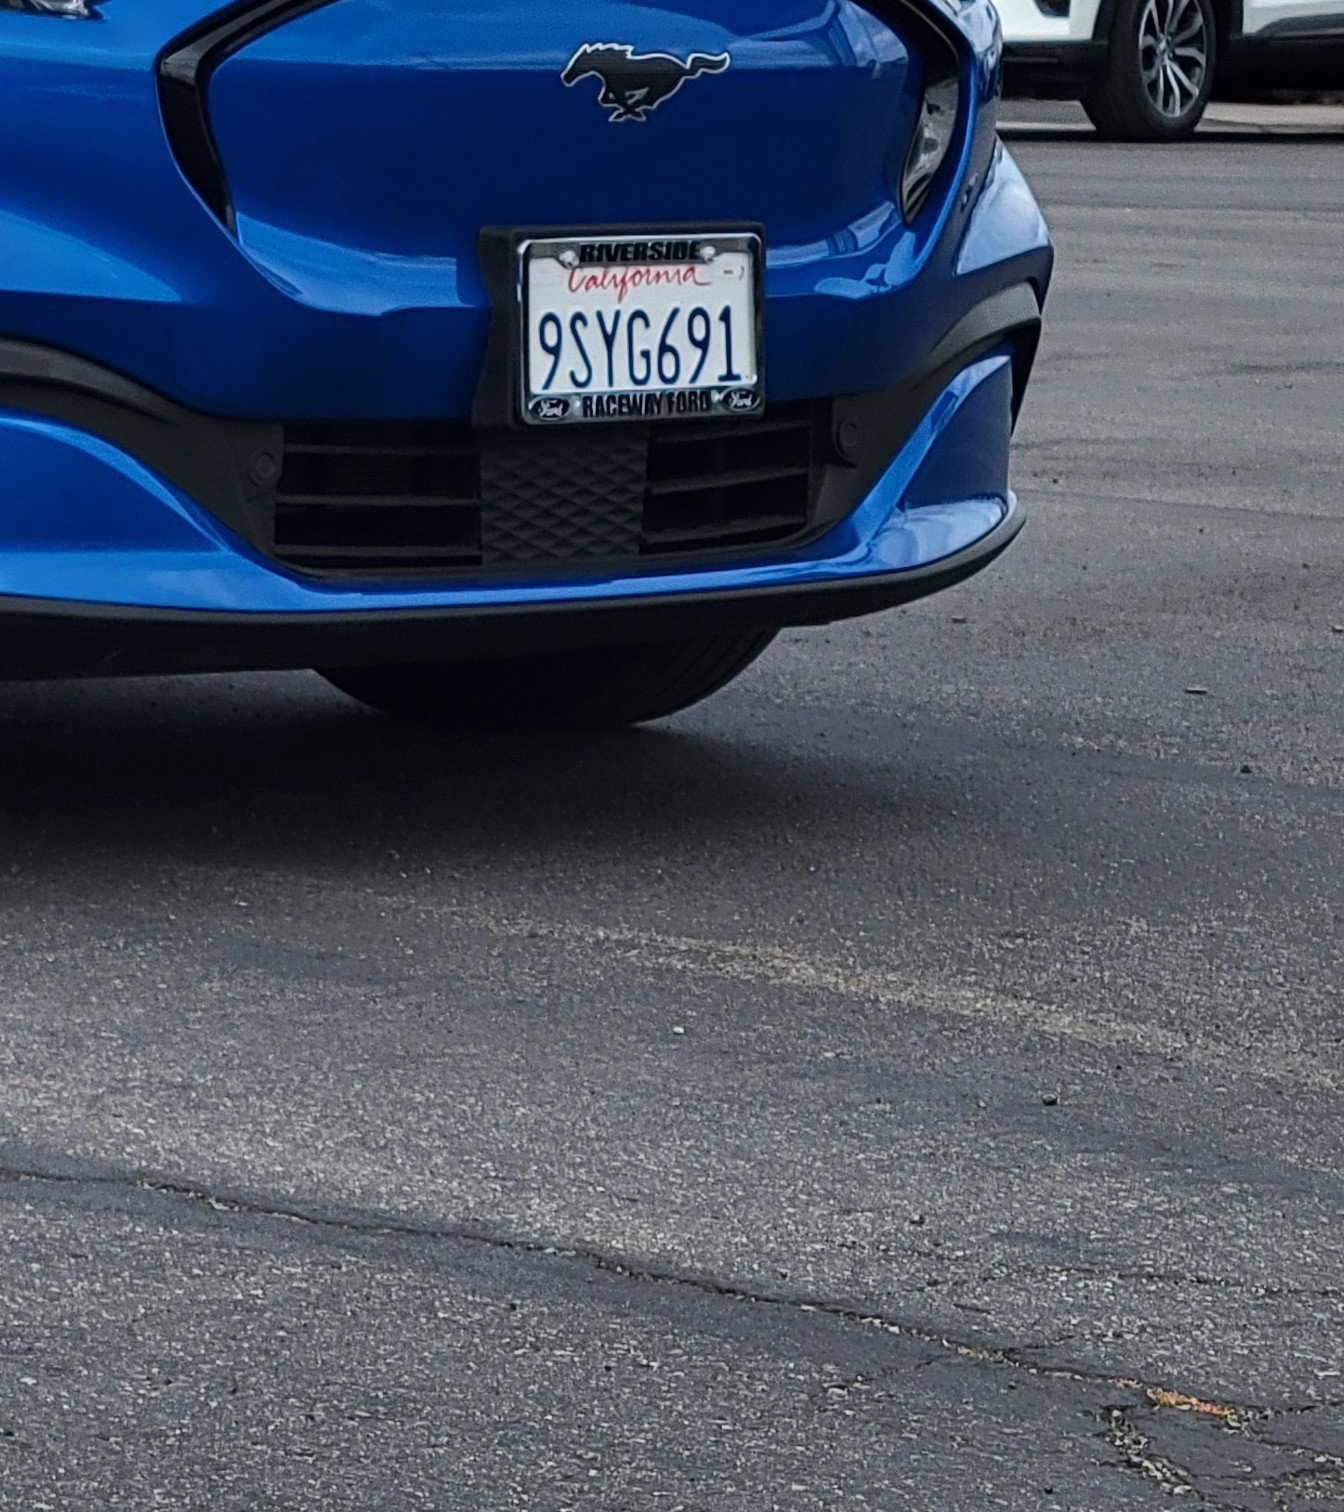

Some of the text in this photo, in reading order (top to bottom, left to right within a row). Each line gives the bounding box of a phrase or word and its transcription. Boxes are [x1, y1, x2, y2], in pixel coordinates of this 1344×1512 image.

[578, 240, 700, 264] RIVERSIDE
[567, 265, 712, 304] California
[538, 304, 742, 390] 9SYG691
[582, 390, 712, 419] RACEWAY FORD
